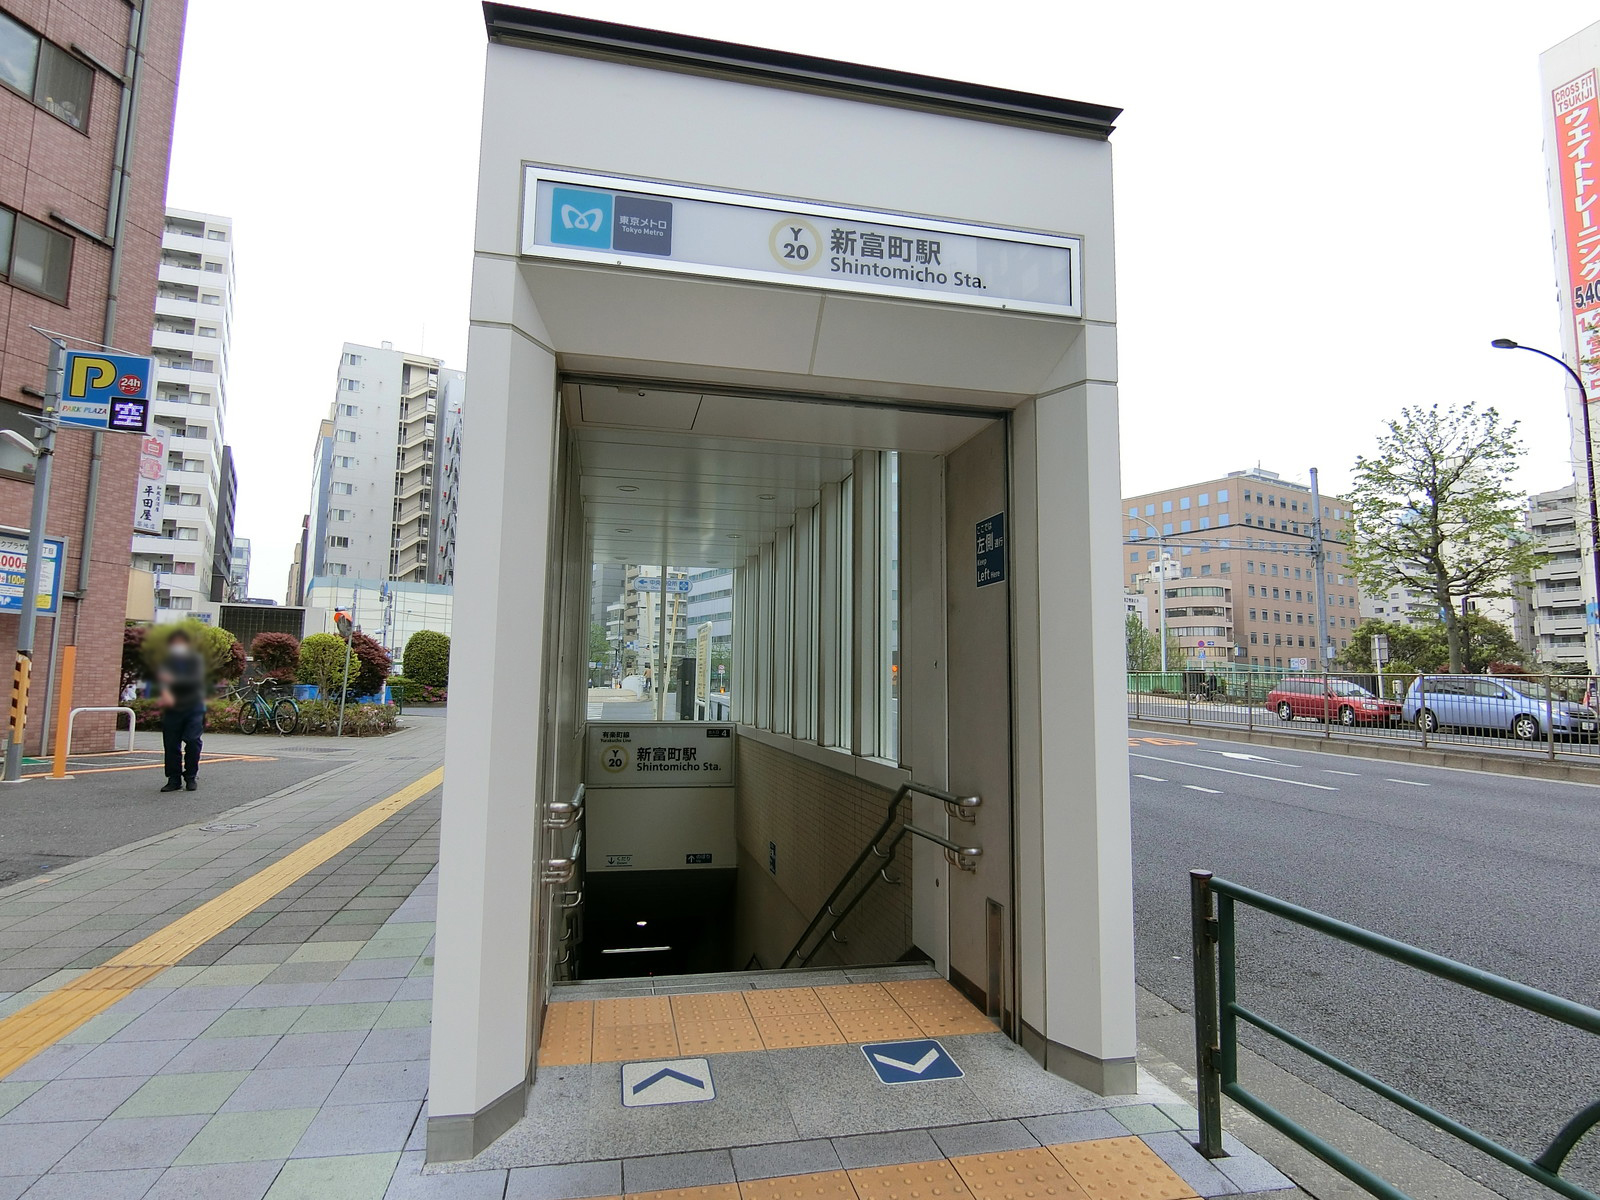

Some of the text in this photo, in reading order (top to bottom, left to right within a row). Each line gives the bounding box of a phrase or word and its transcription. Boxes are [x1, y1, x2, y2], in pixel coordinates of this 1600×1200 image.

[1555, 75, 1592, 102] CROSS FIT
[1558, 87, 1593, 113] TSUKIJI
[619, 215, 667, 229] 東京メトロ
[622, 225, 664, 237] Tokyo Metro
[790, 227, 803, 241] Y
[783, 243, 809, 261] 20
[830, 228, 941, 266] 新富町駅
[830, 257, 987, 289] Shintomicho Sta.
[70, 356, 117, 397] P
[121, 378, 141, 388] 24h
[84, 407, 107, 415] PLAZA
[113, 402, 144, 427] 空
[140, 485, 155, 521] 平田屋
[977, 567, 1001, 583] Left Here
[612, 749, 619, 757] Y
[637, 747, 697, 761] 新富町駅
[608, 758, 622, 767] 20
[637, 762, 721, 771] Shintomicho Sta.
